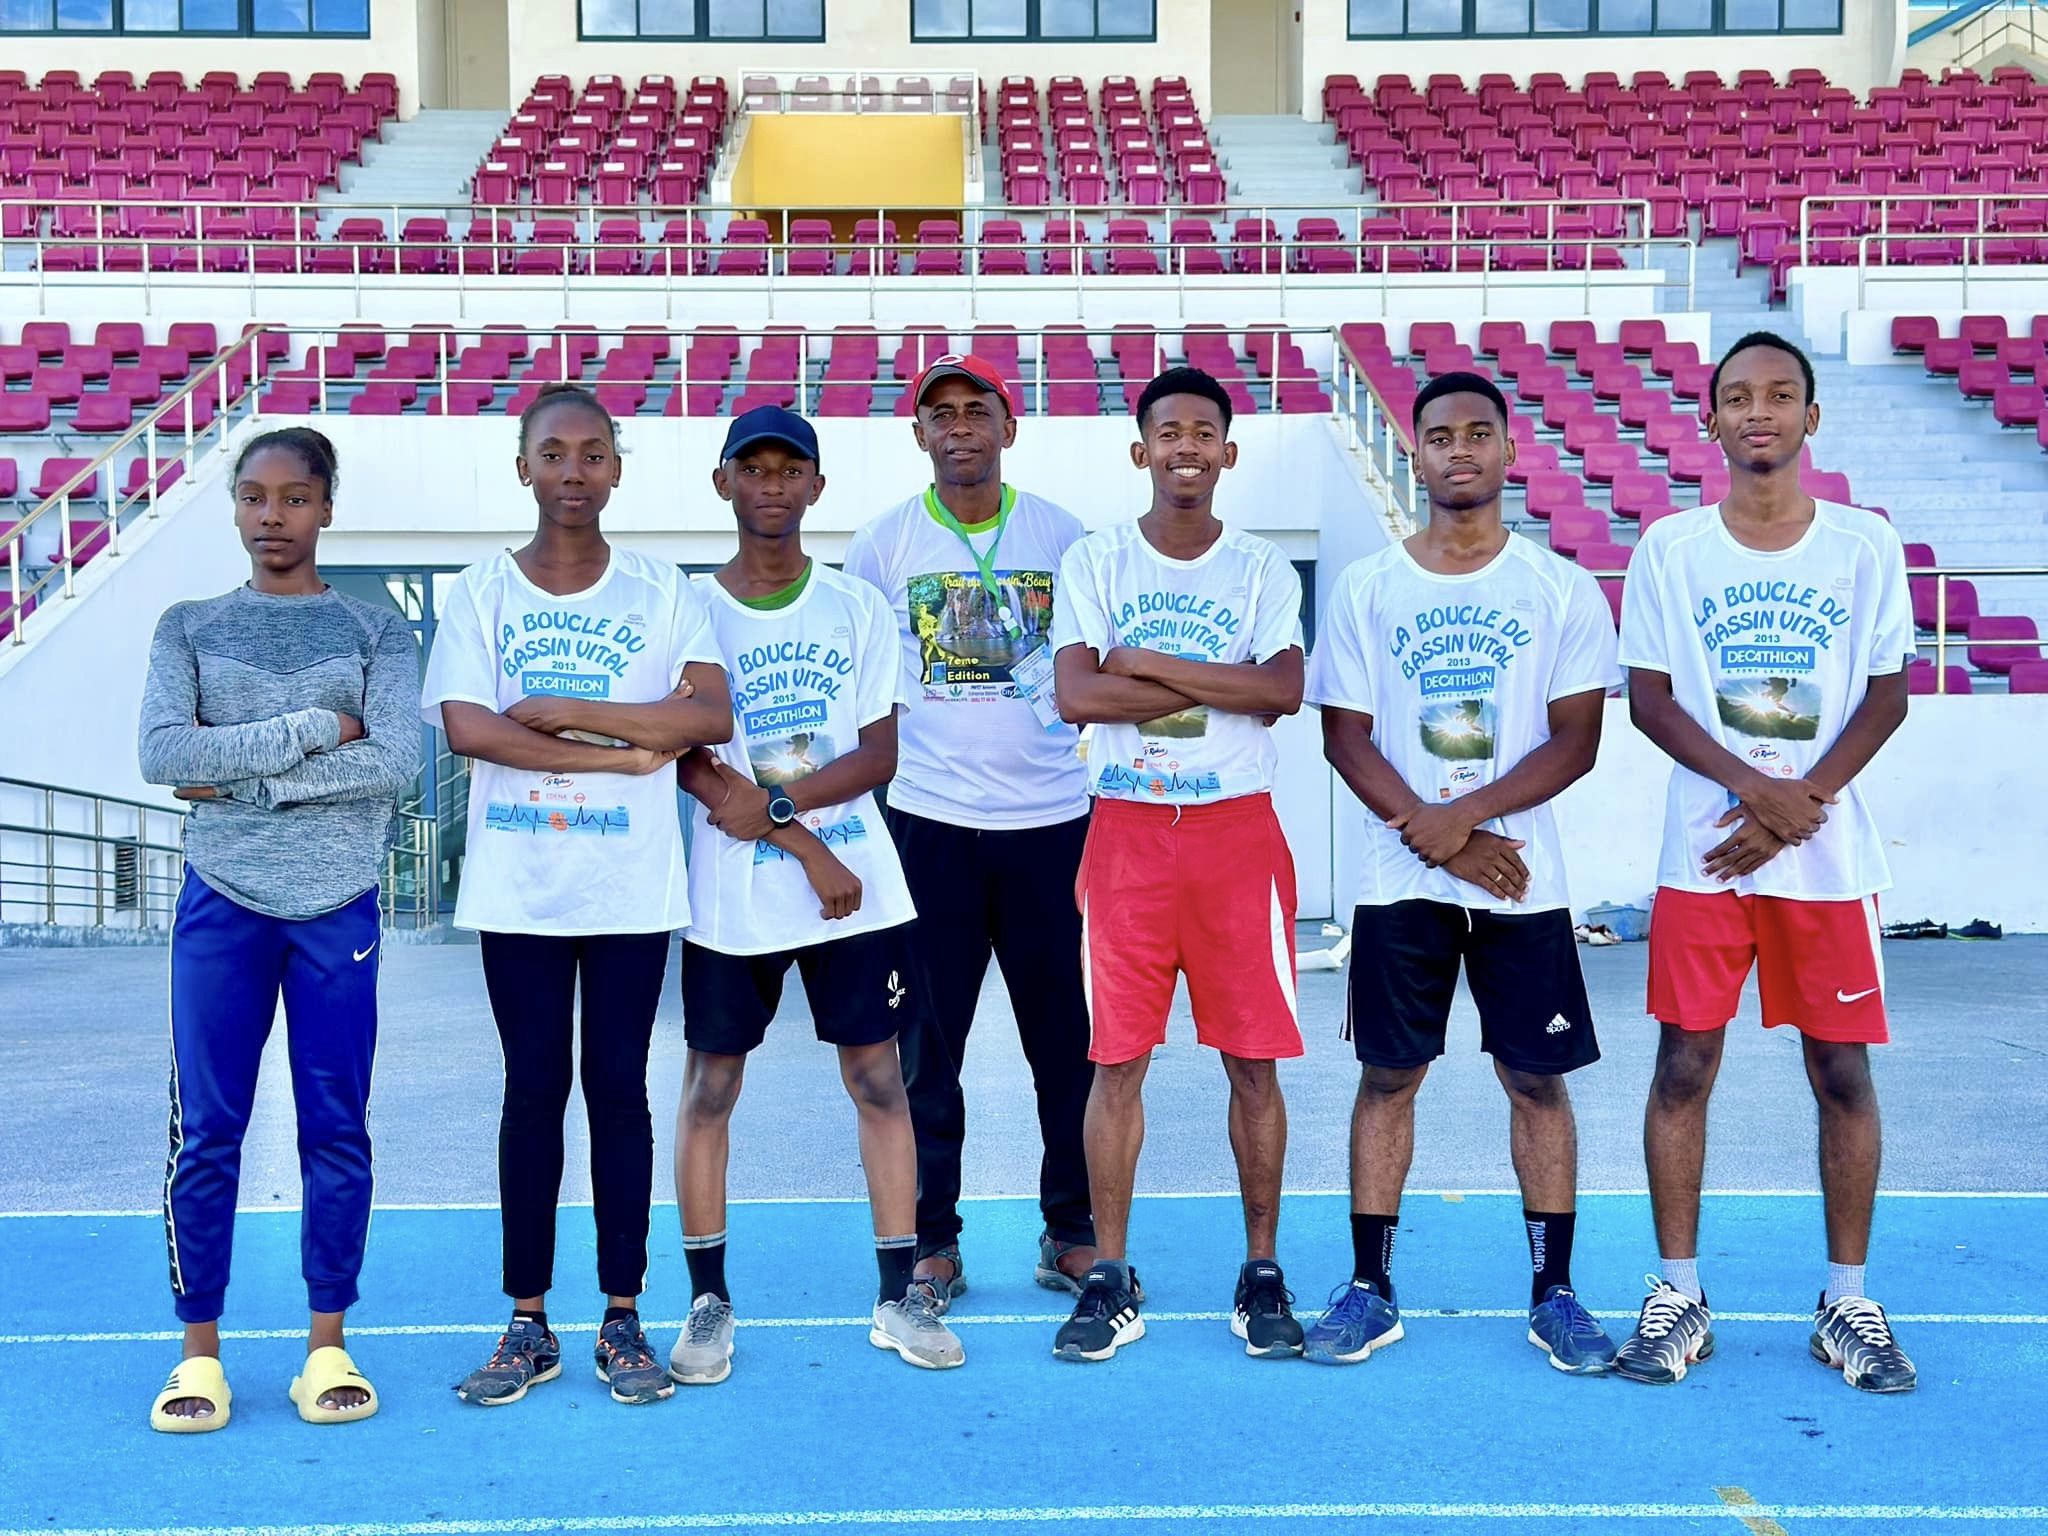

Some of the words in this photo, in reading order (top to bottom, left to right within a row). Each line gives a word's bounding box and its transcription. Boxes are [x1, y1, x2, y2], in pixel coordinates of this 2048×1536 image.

[1112, 602, 1135, 629] LA
[1138, 591, 1216, 617] BOUCLE
[1693, 597, 1717, 628] LA
[1724, 581, 1818, 608] BOUCLE
[1818, 597, 1850, 626] DU
[523, 611, 611, 637] BOUCLE
[612, 625, 646, 653] DU
[1181, 620, 1227, 658] VITAL
[1390, 626, 1411, 657] LA
[1416, 605, 1502, 634] BOUCLE
[1500, 618, 1532, 647] DU
[1704, 610, 1774, 652] BASSIN
[1780, 610, 1835, 650] VITAL
[1754, 634, 1781, 643] 2013
[503, 637, 571, 679] BASSIN
[576, 639, 629, 678] VITAL
[738, 641, 821, 675] BOUCLE
[823, 649, 853, 676] DU
[1158, 641, 1181, 652] 2013
[1401, 633, 1464, 680] BASSIN
[1469, 632, 1515, 670] VITAL
[1727, 650, 1809, 664] DECATHLON
[551, 660, 577, 671] 2013
[947, 671, 990, 681] Edition
[1447, 657, 1471, 667] 2013
[526, 676, 604, 693] DECATHLON
[733, 670, 788, 720] ASSIN
[792, 668, 842, 701] VITAL
[1424, 671, 1492, 689] DECATHLON
[772, 693, 796, 704] 2013
[750, 705, 821, 729] DECATHLON
